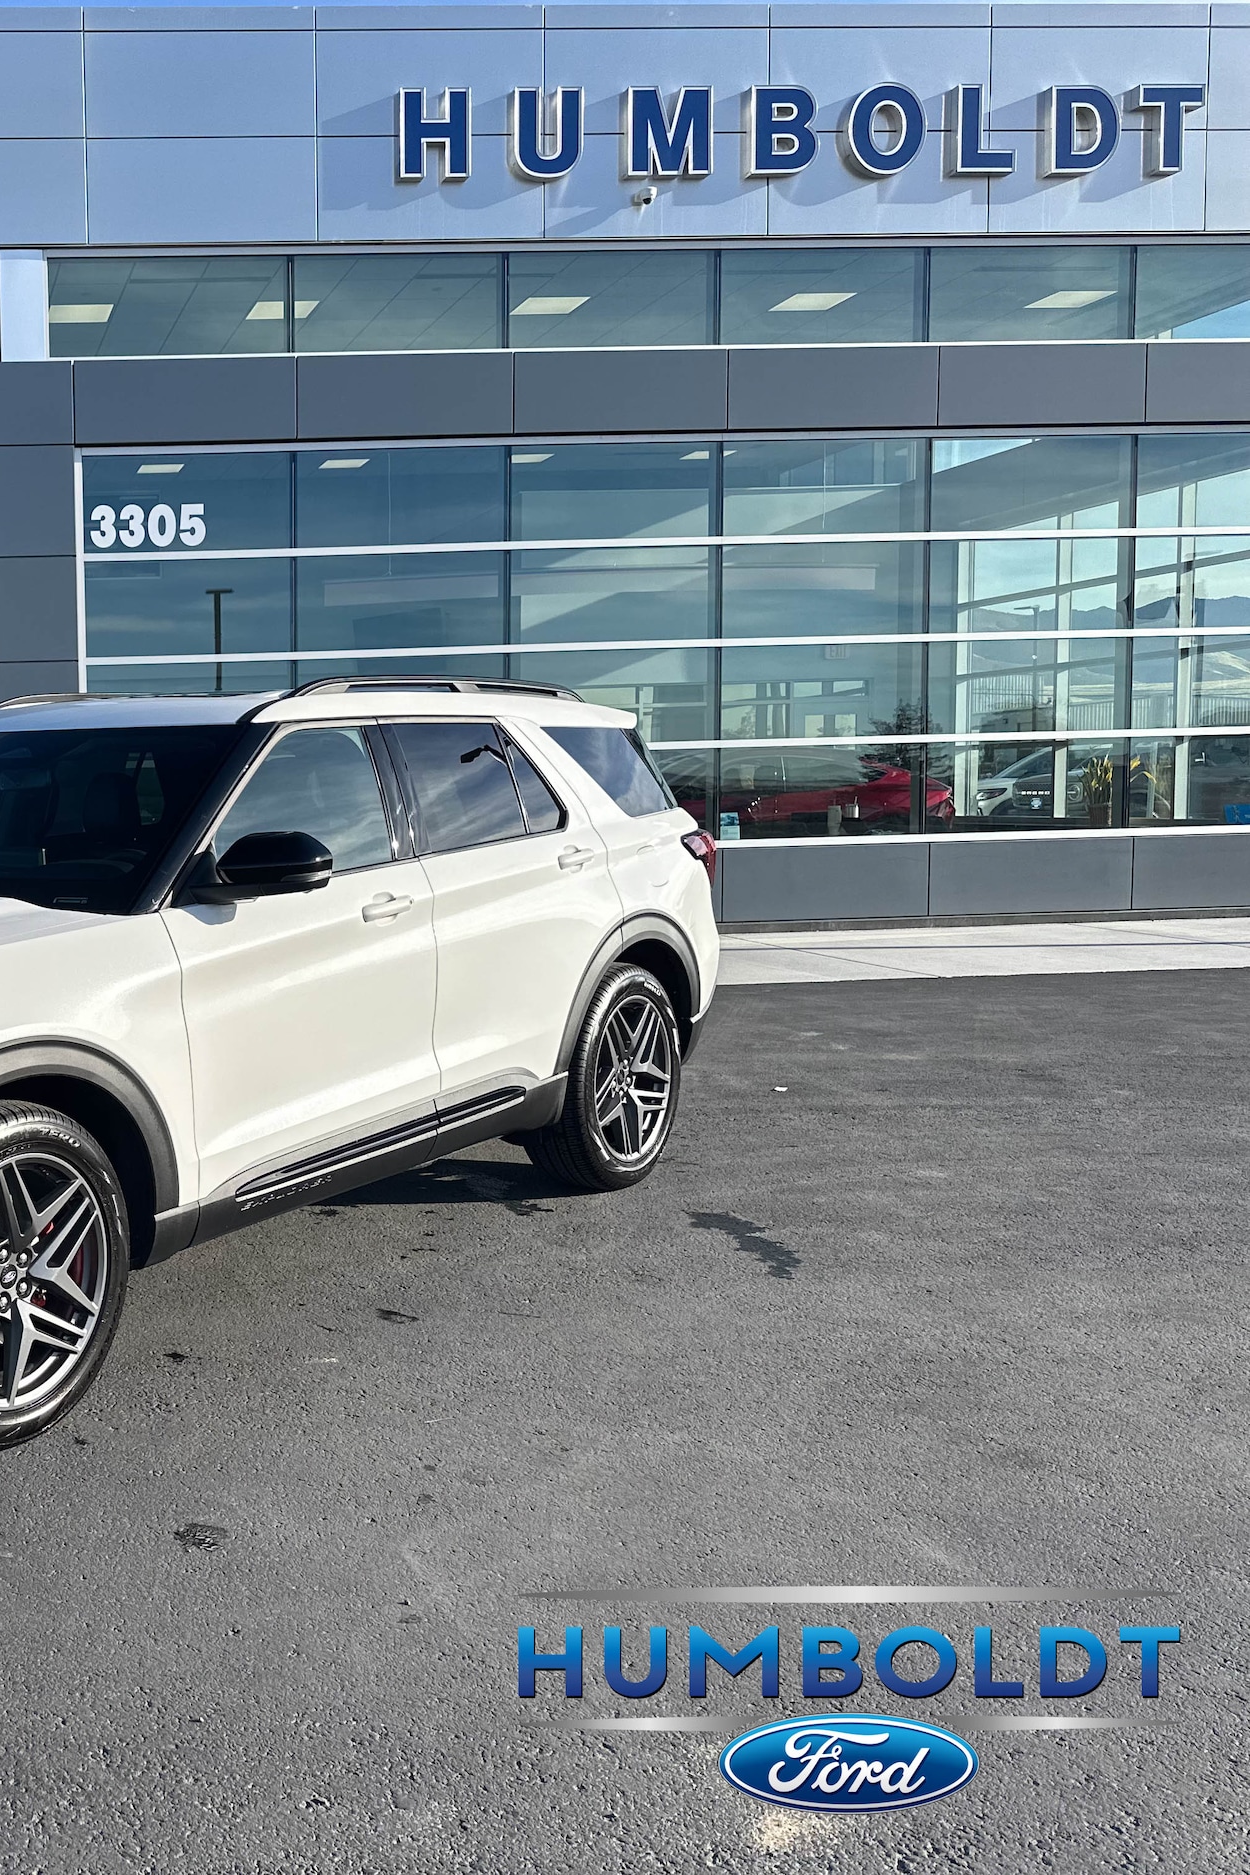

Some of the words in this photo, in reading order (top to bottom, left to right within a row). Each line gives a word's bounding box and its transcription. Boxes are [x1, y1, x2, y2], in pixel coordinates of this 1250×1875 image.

[396, 82, 1206, 181] HUMBOLDT
[90, 503, 207, 549] 3305
[39, 1127, 81, 1149] ZERO
